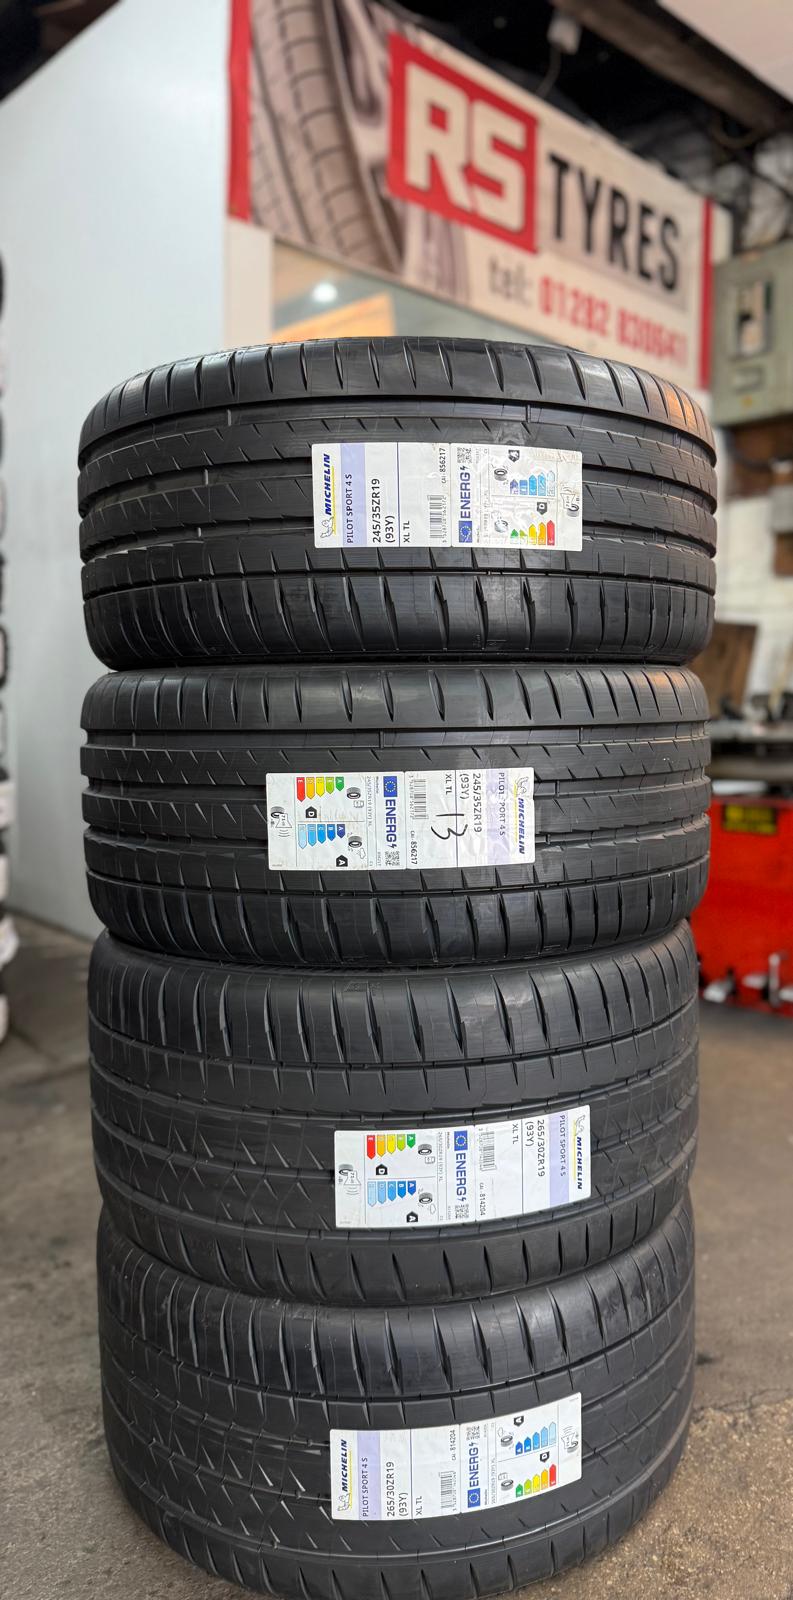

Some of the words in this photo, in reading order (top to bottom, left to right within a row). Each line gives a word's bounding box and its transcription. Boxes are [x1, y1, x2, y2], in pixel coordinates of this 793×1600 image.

[404, 61, 527, 236] RS
[548, 152, 679, 292] TYRES
[323, 453, 332, 516] MICHELIN
[345, 488, 353, 517] SPORT
[371, 478, 382, 543] 245/35ZR19
[346, 517, 354, 544] PILOT
[385, 515, 396, 543] (93Y)
[403, 520, 410, 530] TL
[403, 533, 410, 543] XL
[445, 774, 452, 783] XL
[445, 785, 453, 795] TL
[459, 773, 469, 800] (93Y)
[472, 773, 482, 833] 245/35ZR19
[430, 813, 468, 840] 13
[410, 841, 418, 865] 856217
[512, 1123, 518, 1134] XL
[512, 1135, 519, 1144] TL
[525, 1121, 534, 1147] (93Y)
[537, 1119, 545, 1177] 265/30ZR19
[340, 1439, 348, 1492] MICHELIN
[361, 1470, 369, 1494] SPORT
[386, 1461, 395, 1517] 265/30ZR19
[398, 1492, 408, 1517] (93Y)
[416, 1496, 422, 1504] TL
[416, 1505, 422, 1515] XL
